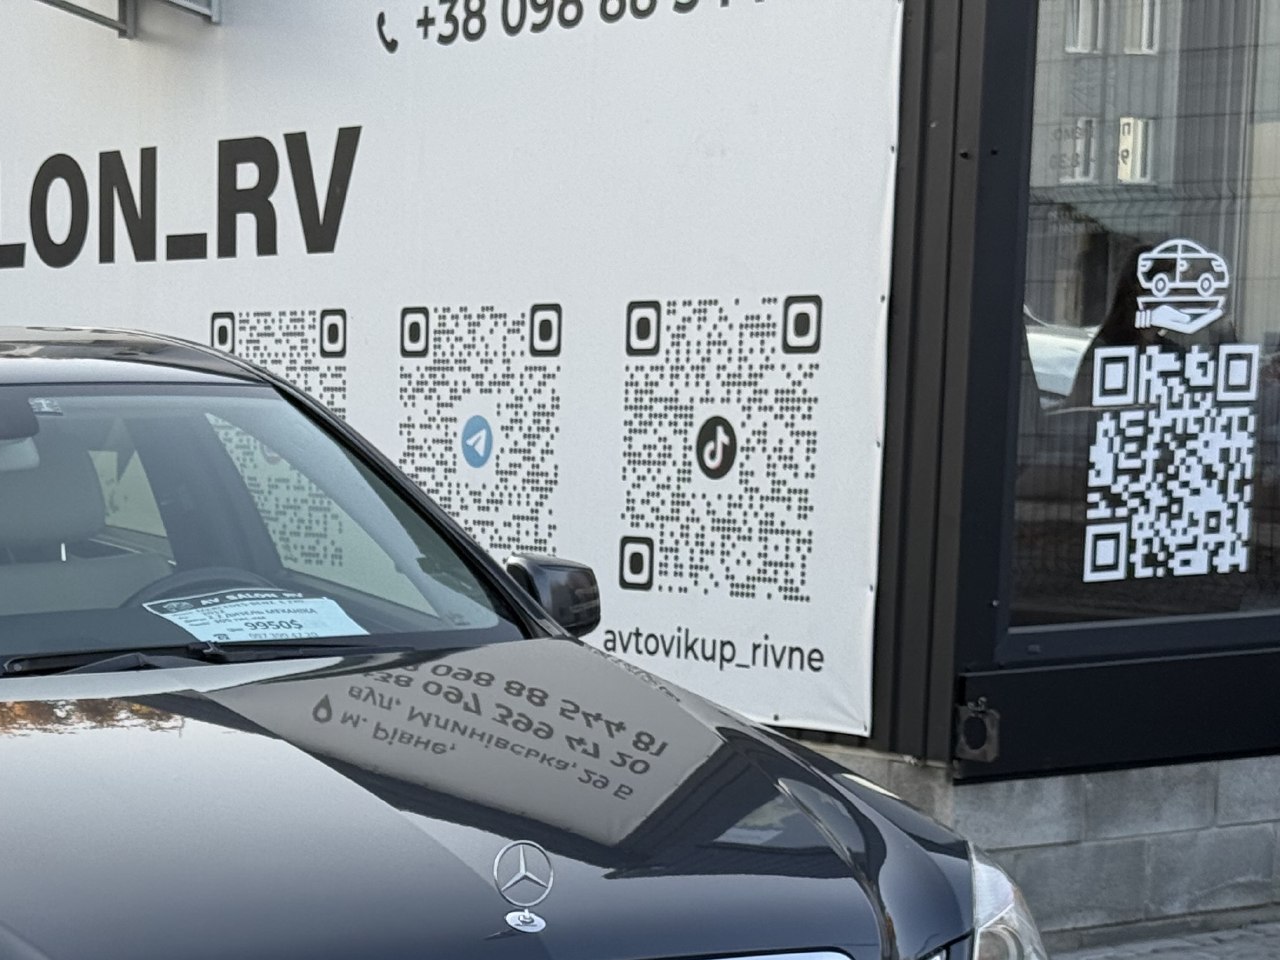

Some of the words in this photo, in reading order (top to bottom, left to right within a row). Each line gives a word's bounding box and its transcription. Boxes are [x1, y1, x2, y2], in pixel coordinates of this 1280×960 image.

[416, 0, 487, 45] +38
[200, 597, 220, 606] AV
[225, 592, 278, 600] SALON
[244, 619, 303, 631] 9950$
[602, 625, 826, 673] avtovikup_rivne
